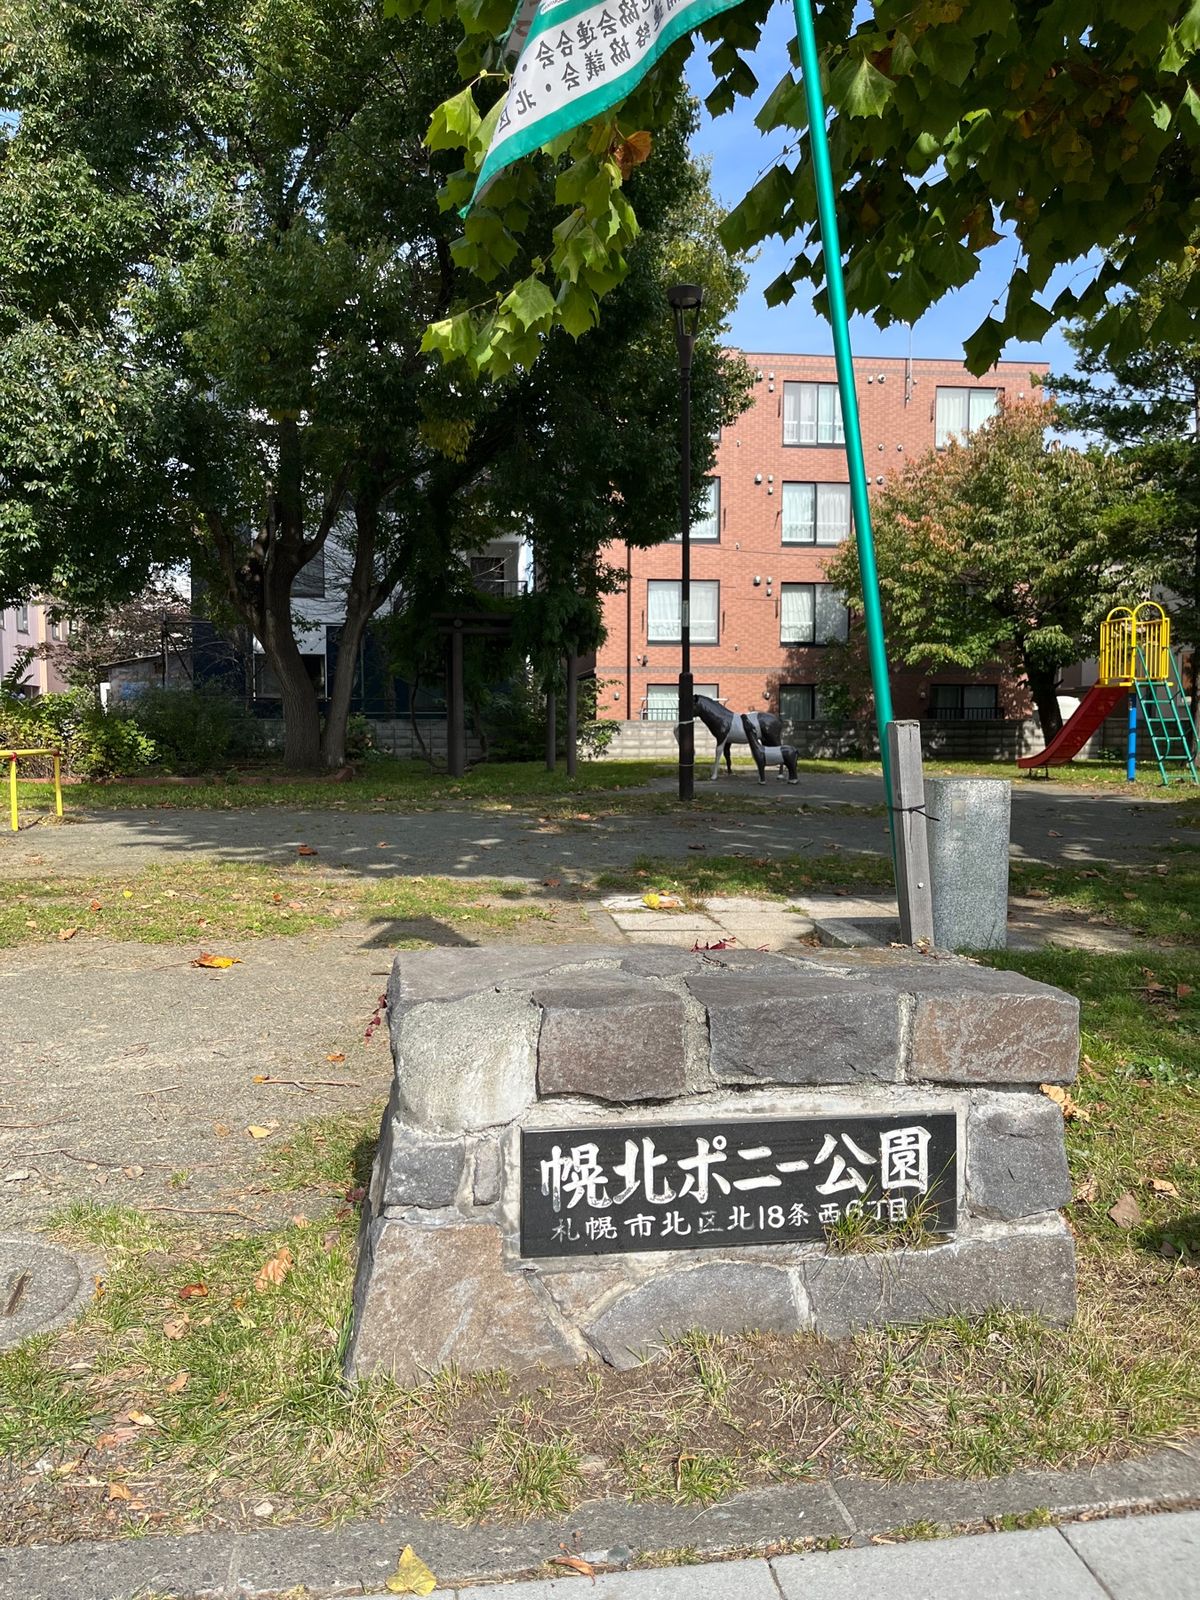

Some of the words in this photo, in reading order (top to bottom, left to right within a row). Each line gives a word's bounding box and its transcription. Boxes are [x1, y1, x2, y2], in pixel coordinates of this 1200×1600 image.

[541, 1126, 931, 1212] 幌北ポニー公園
